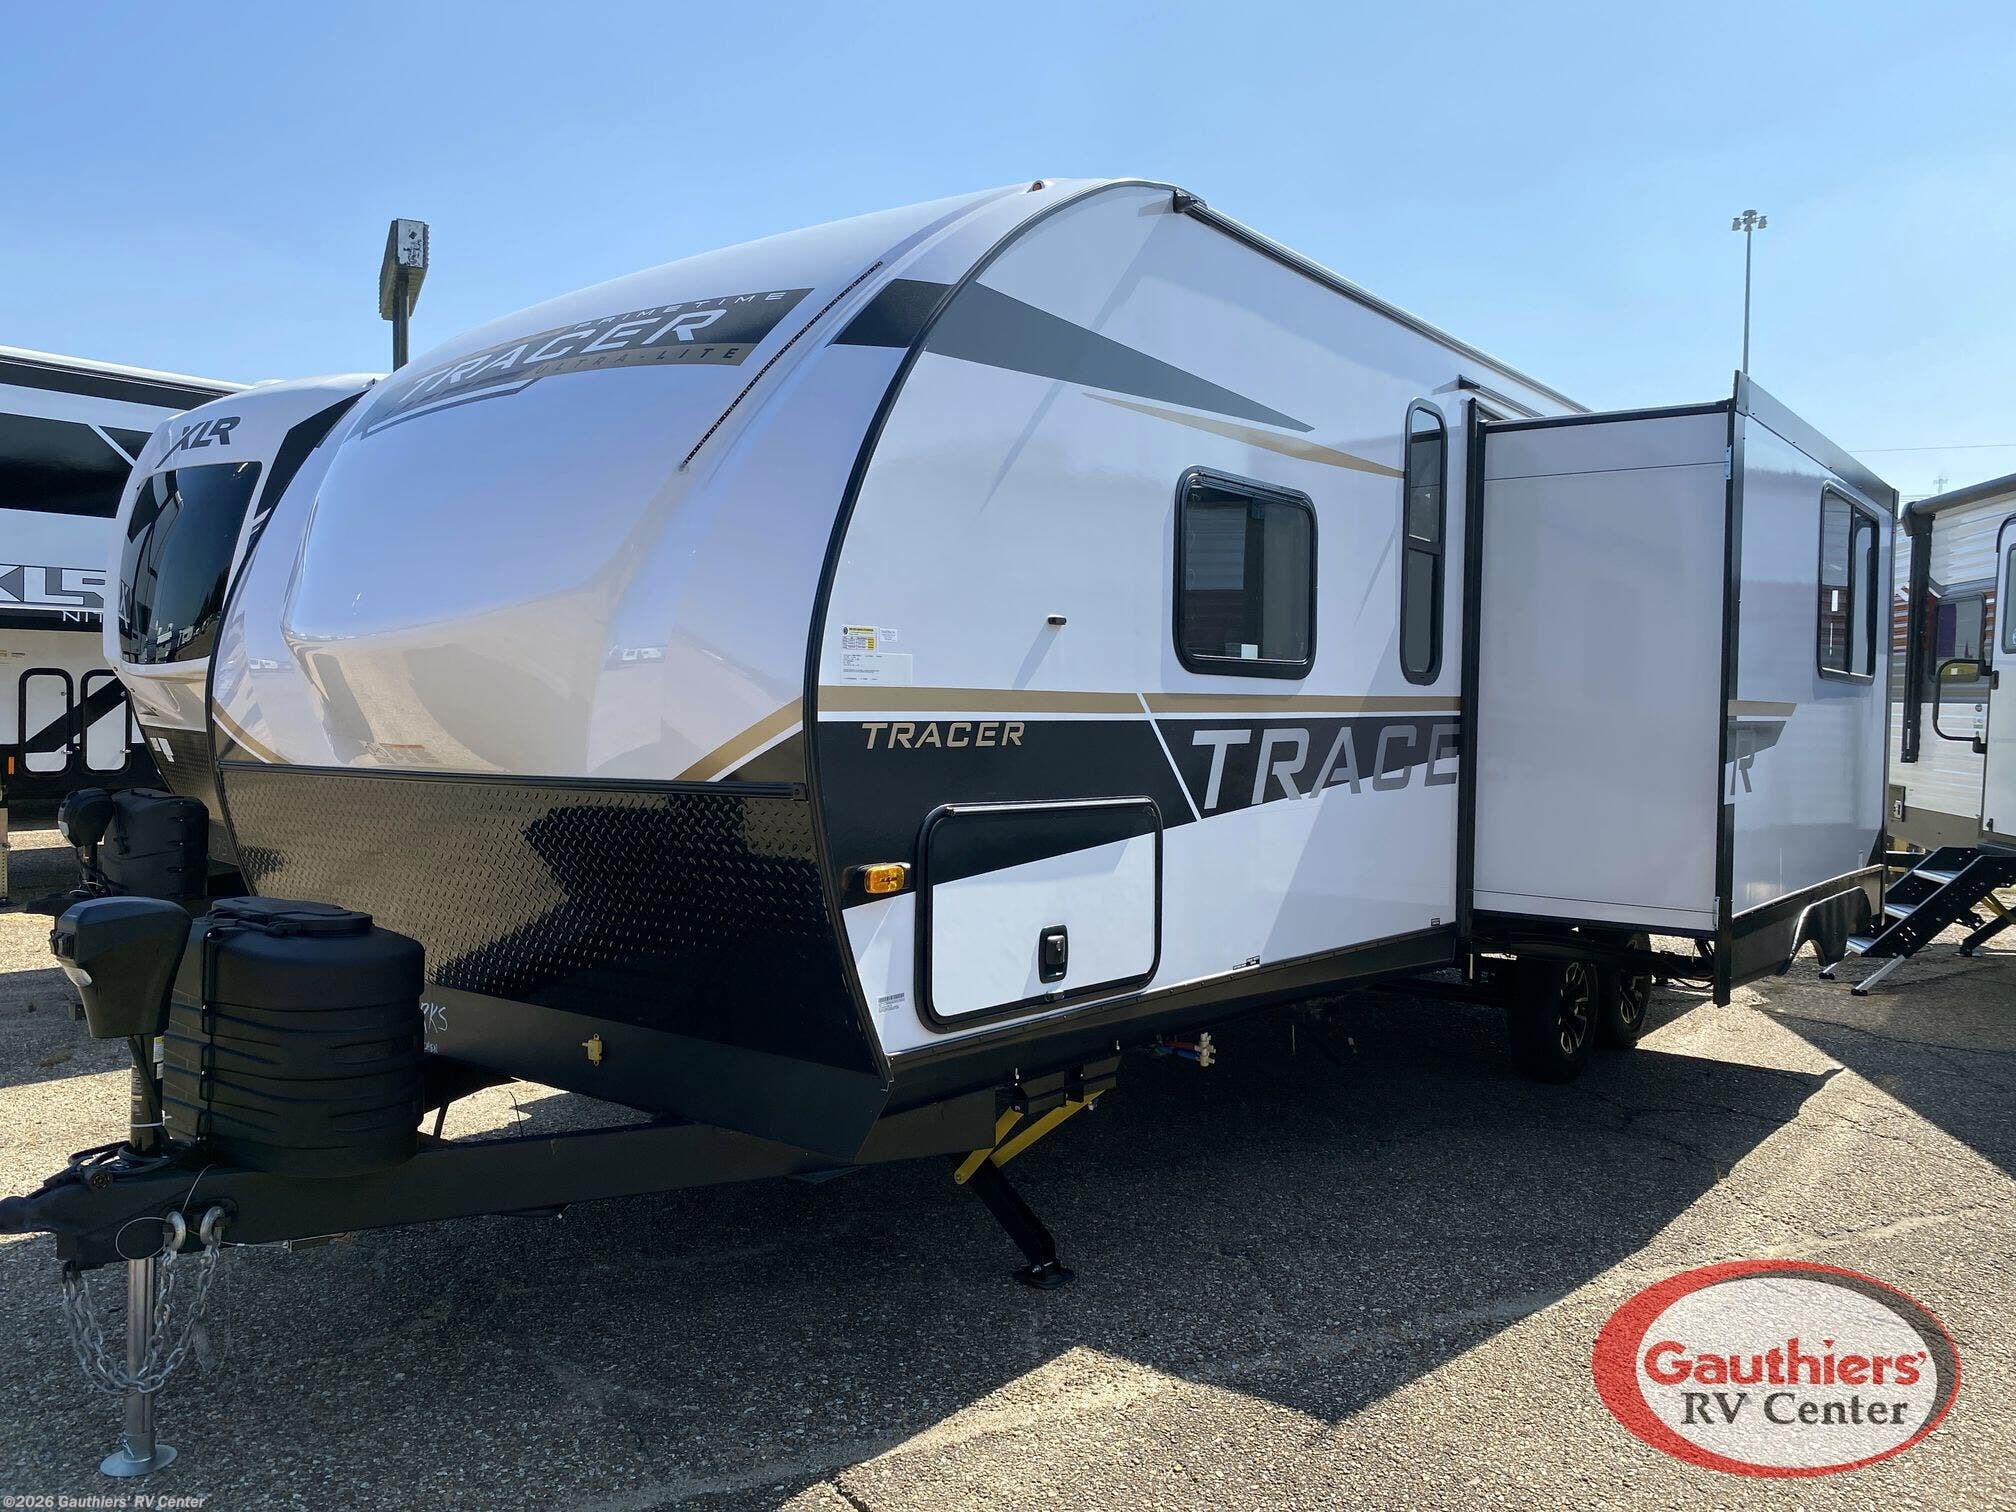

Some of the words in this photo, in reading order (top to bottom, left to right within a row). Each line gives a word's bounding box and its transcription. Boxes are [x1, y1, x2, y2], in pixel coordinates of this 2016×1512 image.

[399, 308, 728, 403] TRACER
[154, 416, 241, 469] XLR
[862, 722, 1025, 750] TRACER
